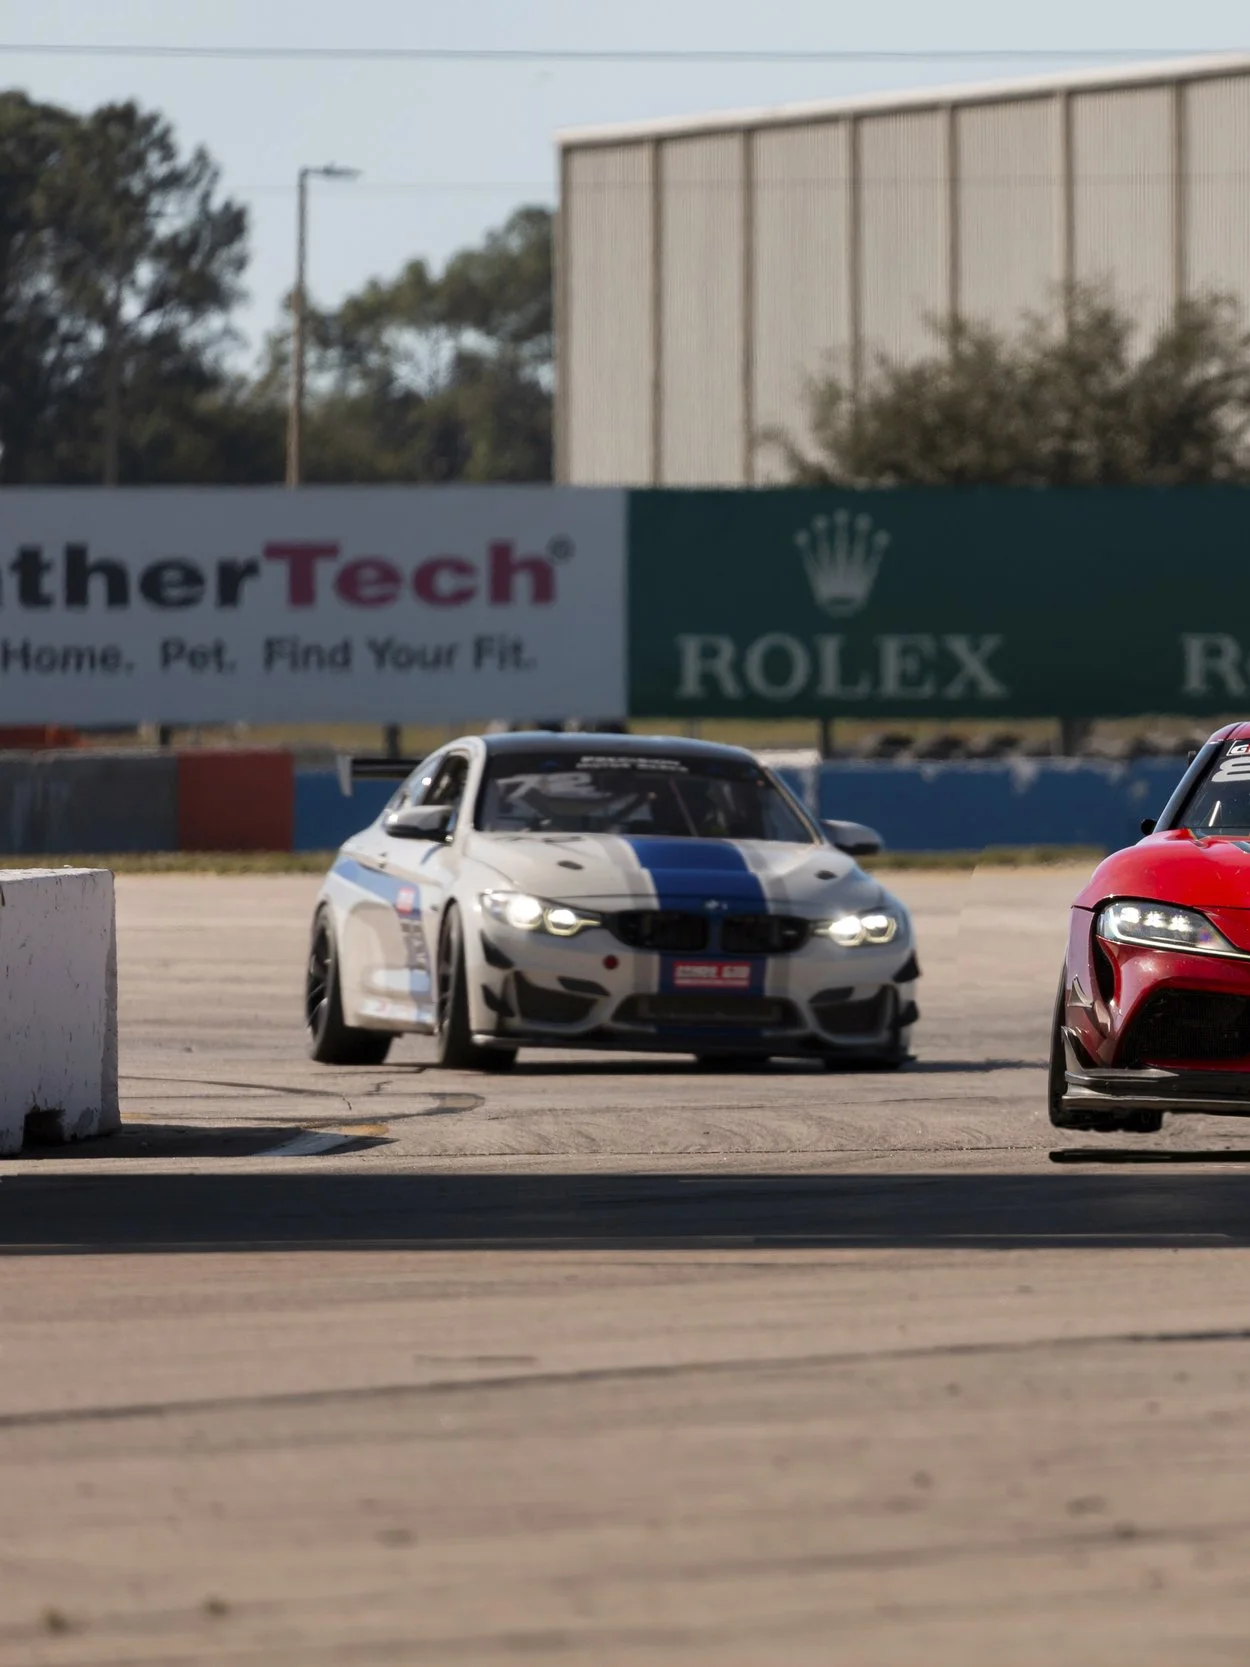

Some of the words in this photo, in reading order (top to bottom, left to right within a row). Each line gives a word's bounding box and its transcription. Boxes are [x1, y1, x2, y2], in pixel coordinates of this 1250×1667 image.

[0, 638, 135, 674] Home.
[160, 639, 237, 673] Pet.
[263, 637, 352, 672] Find
[366, 637, 459, 672] Your
[472, 635, 537, 671] Fit.
[675, 631, 1008, 700] ROLEX
